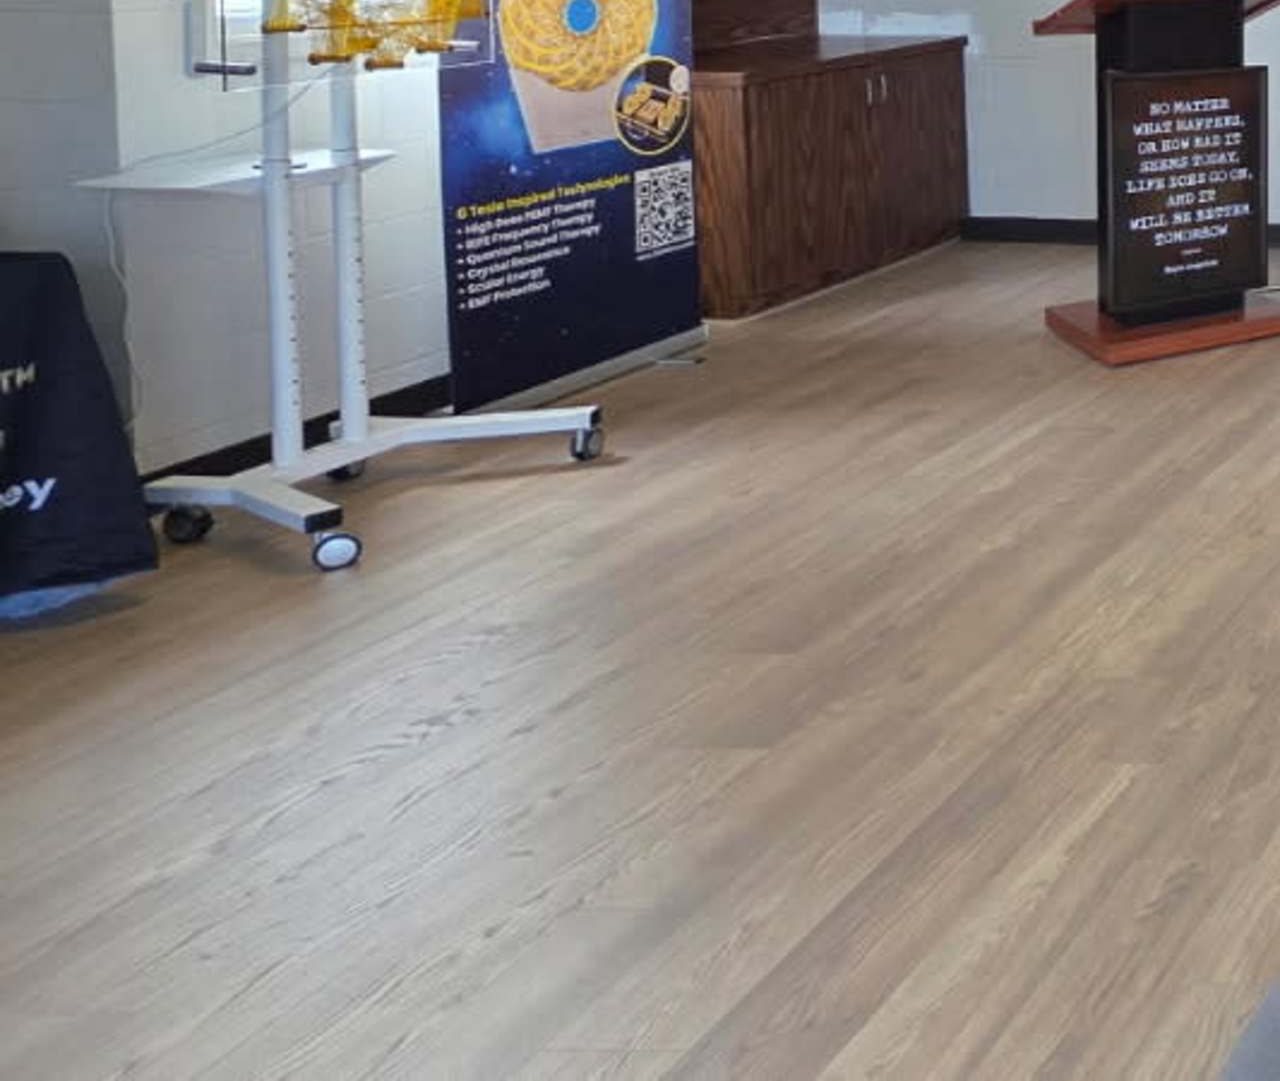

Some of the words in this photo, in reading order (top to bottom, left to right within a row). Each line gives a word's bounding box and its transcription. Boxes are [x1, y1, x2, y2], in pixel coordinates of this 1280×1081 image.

[1149, 102, 1170, 116] NO
[1173, 98, 1230, 113] MATTER
[1133, 120, 1173, 136] WHAT
[1138, 142, 1158, 155] OR
[1161, 138, 1190, 152] HOW
[1193, 134, 1221, 148] BAD
[1224, 132, 1242, 146] IT
[1139, 157, 1189, 173] SEEMS
[1126, 177, 1165, 193] LIFE
[1168, 172, 1206, 188] DOES
[1208, 170, 1227, 183] GO
[469, 201, 505, 217] Tesla
[1167, 192, 1197, 207] AND
[1198, 189, 1216, 203] IT
[465, 220, 494, 235] High
[553, 198, 596, 215] Therapy
[491, 223, 549, 243] Frequency
[551, 212, 594, 230] Therapy
[1129, 214, 1168, 230] WILL
[1172, 211, 1192, 224] BE
[1195, 203, 1250, 221] BETTER
[466, 245, 522, 265] Quantum
[523, 232, 558, 250] Sound
[559, 223, 602, 241] Therapy
[1154, 223, 1228, 246] TOMORROW
[467, 260, 510, 280] Crystal
[511, 246, 571, 268] Resonance
[506, 267, 545, 285] Energy
[493, 279, 551, 301] Protection
